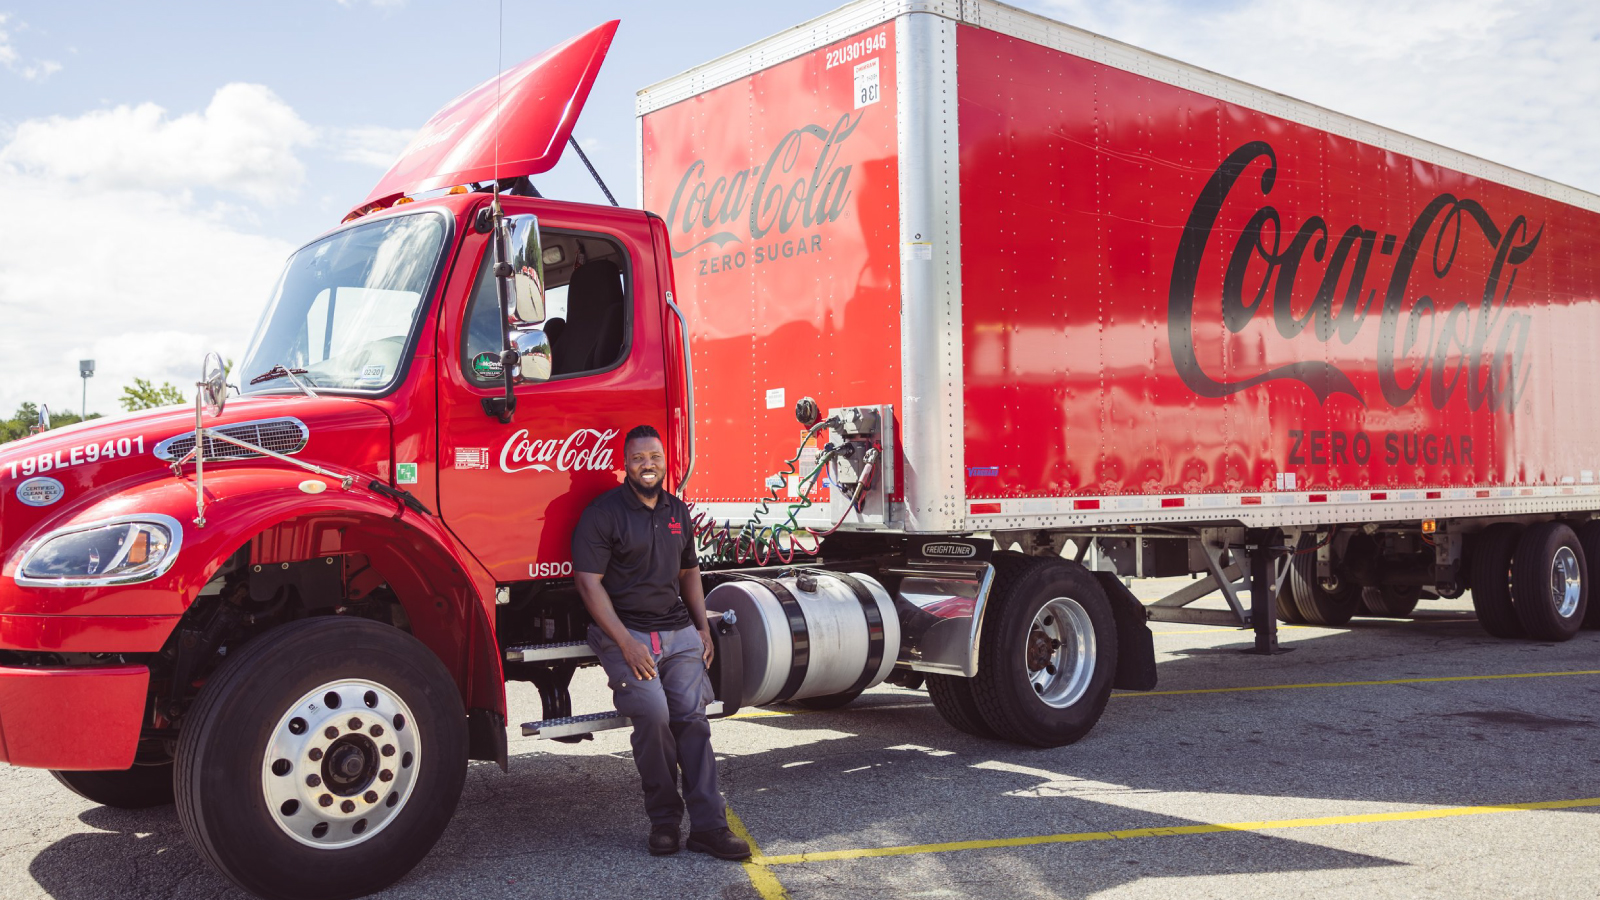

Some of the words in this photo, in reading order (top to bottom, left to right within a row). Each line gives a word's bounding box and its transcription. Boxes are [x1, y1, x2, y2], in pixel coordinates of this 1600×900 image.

[826, 32, 886, 70] 22U301946
[666, 108, 864, 258] Coca-Cola
[699, 251, 746, 276] ZERO
[755, 234, 822, 264] SUGAR
[1168, 140, 1544, 414] Coca-Cola
[6, 435, 145, 479] 19BLE9401
[499, 428, 620, 473] Coca-Cola
[1288, 430, 1371, 466] ZERO
[1385, 433, 1474, 466] SUGAR
[528, 561, 574, 577] USDO
[926, 545, 971, 554] FREIGHTLINER
